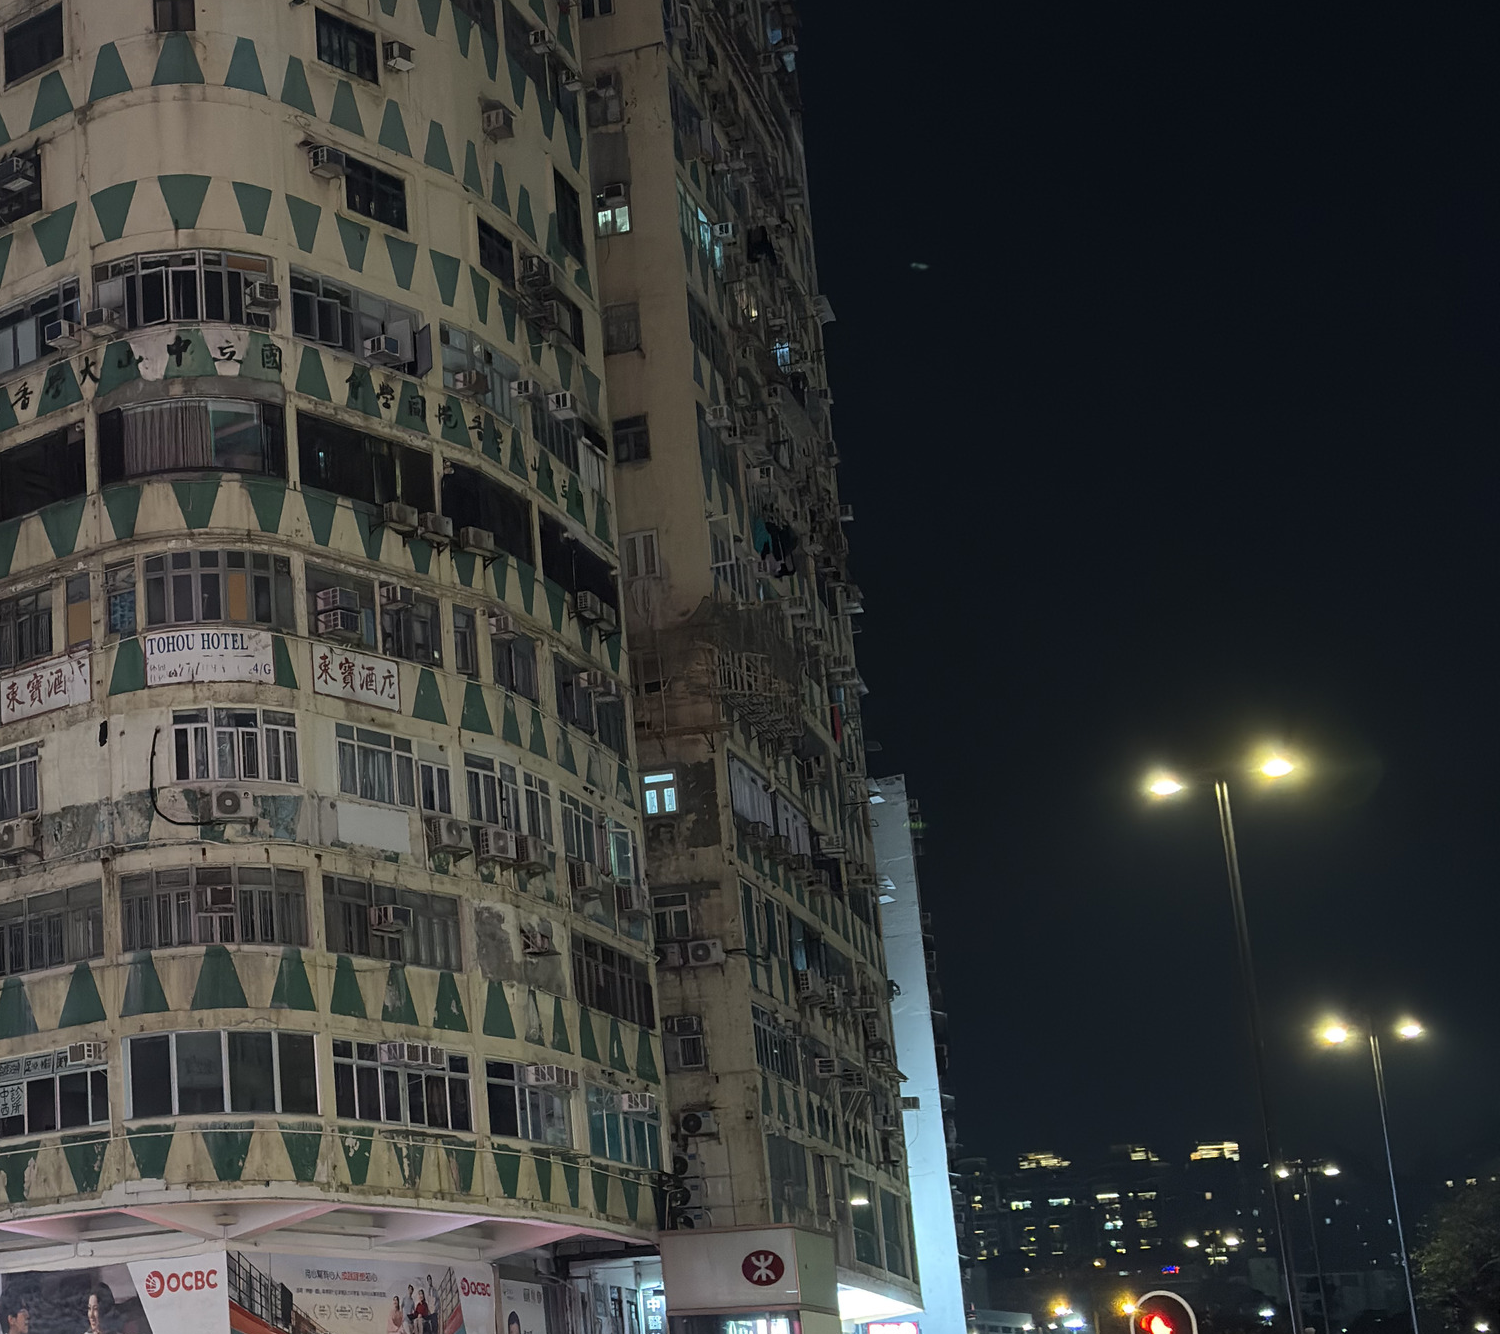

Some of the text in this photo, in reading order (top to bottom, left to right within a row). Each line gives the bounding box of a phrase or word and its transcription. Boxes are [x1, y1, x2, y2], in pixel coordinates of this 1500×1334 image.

[147, 634, 195, 655] TOHOU
[201, 633, 248, 650] HOTEL
[167, 1269, 218, 1292] OCBC
[470, 1281, 491, 1296] OCBC
